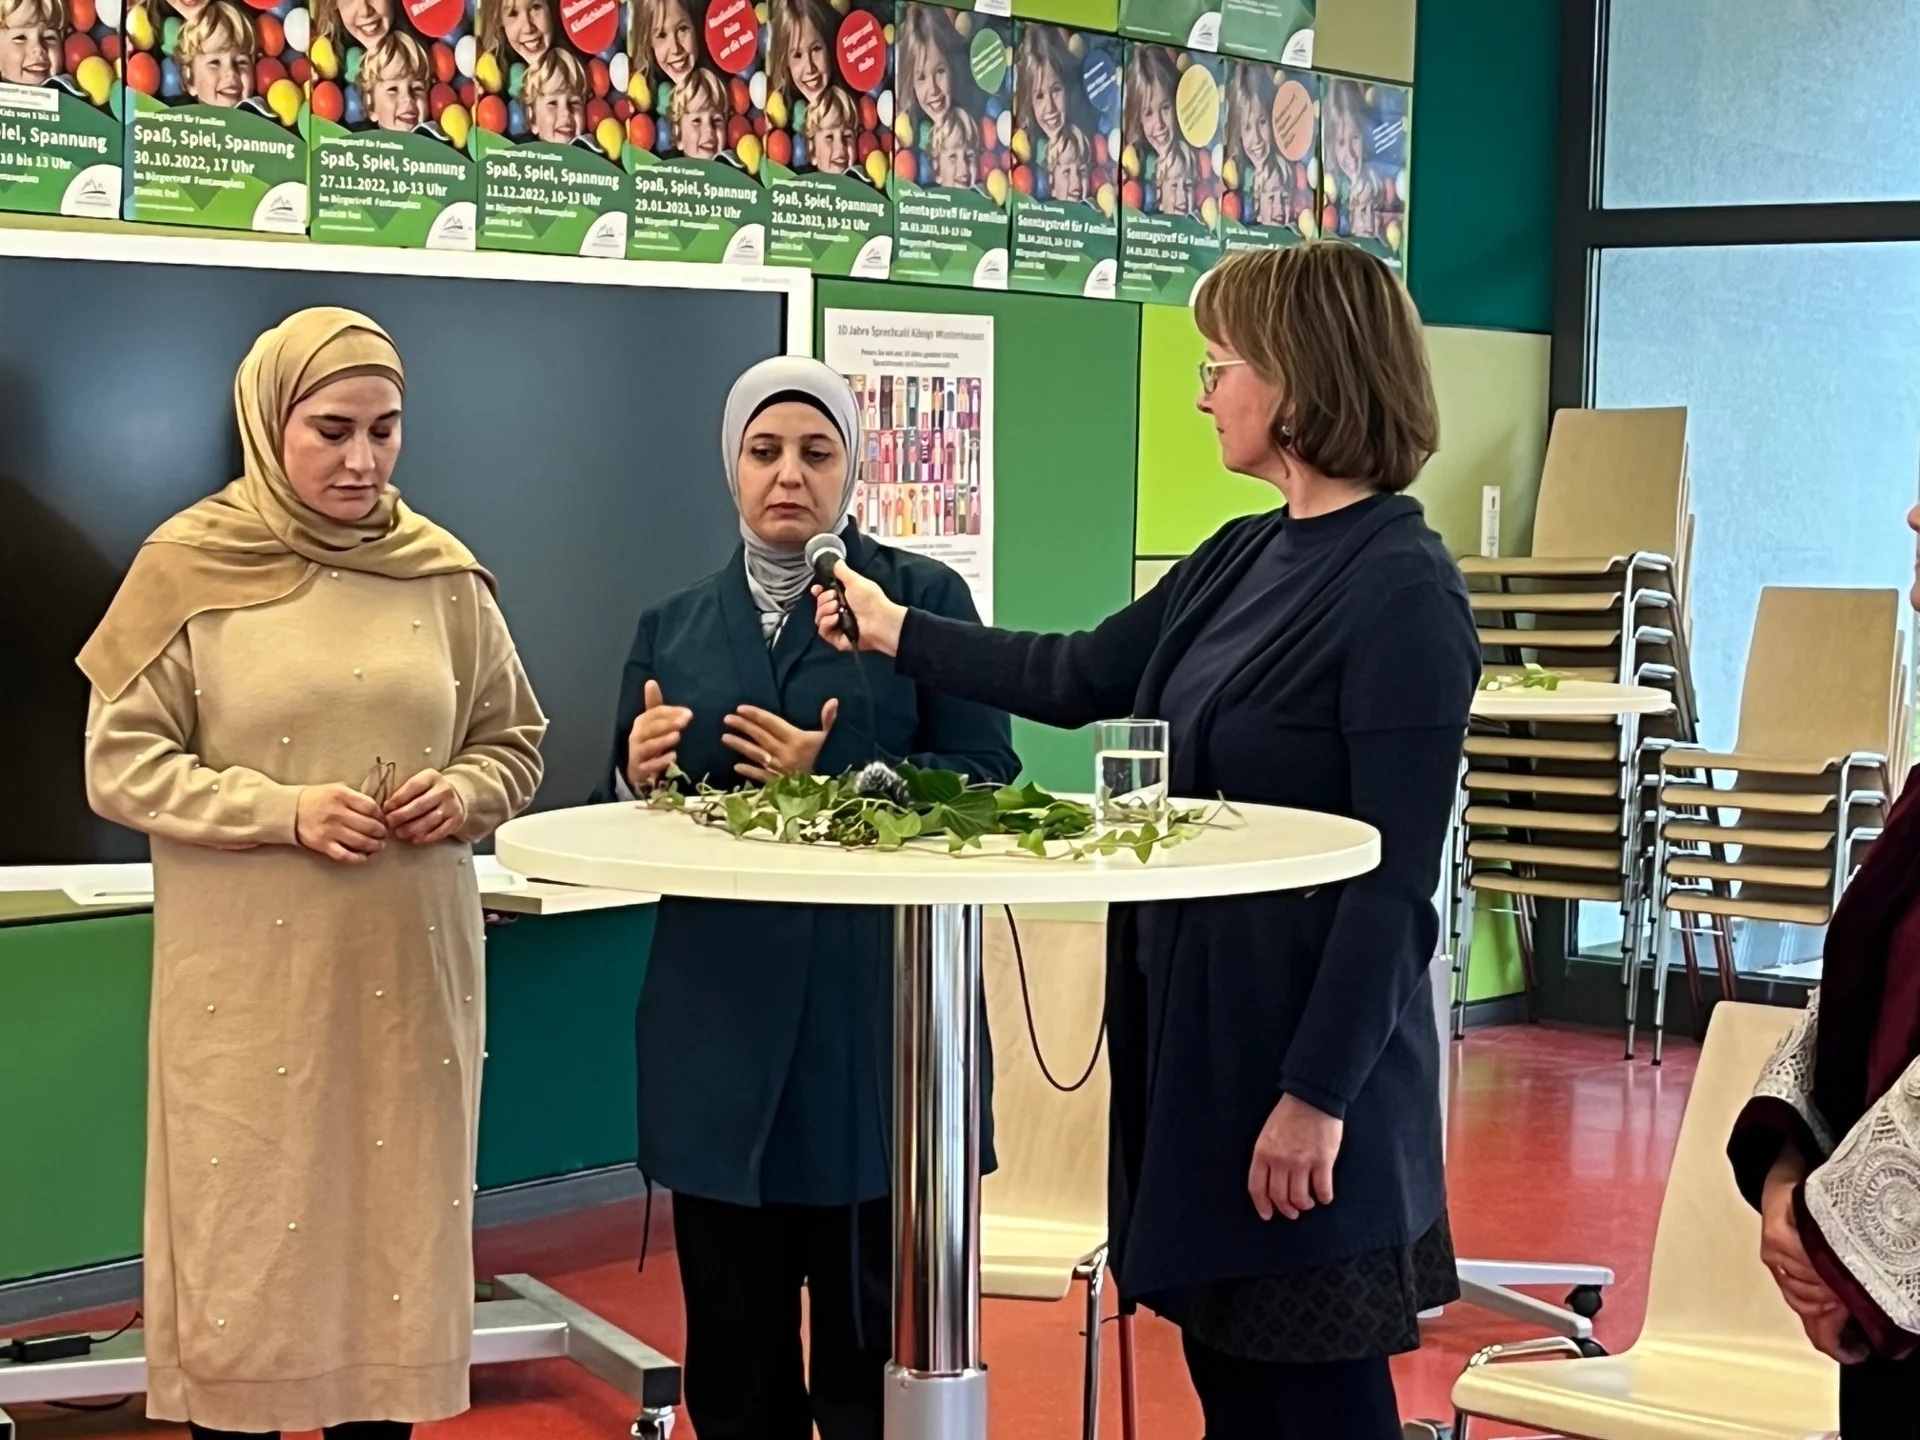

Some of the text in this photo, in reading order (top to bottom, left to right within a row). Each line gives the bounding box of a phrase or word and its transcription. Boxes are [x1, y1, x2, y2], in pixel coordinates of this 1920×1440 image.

[0, 123, 107, 153] iel, Spannung
[134, 126, 295, 159] Spaß, Spiel, Spannung
[16, 153, 32, 166] bis
[36, 156, 48, 168] 13
[52, 157, 72, 169] Uhr
[134, 151, 255, 174] 30.10.2022, 17 Uhr
[320, 151, 466, 180] Spaß, Spiel, Spannung
[320, 175, 448, 197] 27.11.2022, 10-13 Uhr
[486, 161, 619, 191] Spaß, Spiel, Spannung
[486, 184, 602, 206] 11.12.2022, 10-13 Uhr
[635, 176, 668, 195] Spaß,
[671, 180, 702, 198] Spiel,
[704, 183, 758, 204] Spannung
[635, 198, 742, 218] 29.01.2023, 10-12 Uhr
[772, 190, 884, 217] Spaß, Spiel, Spannung
[771, 211, 825, 230] 26.02.2023,
[853, 219, 870, 231] Uhr
[849, 326, 869, 335] Jahre
